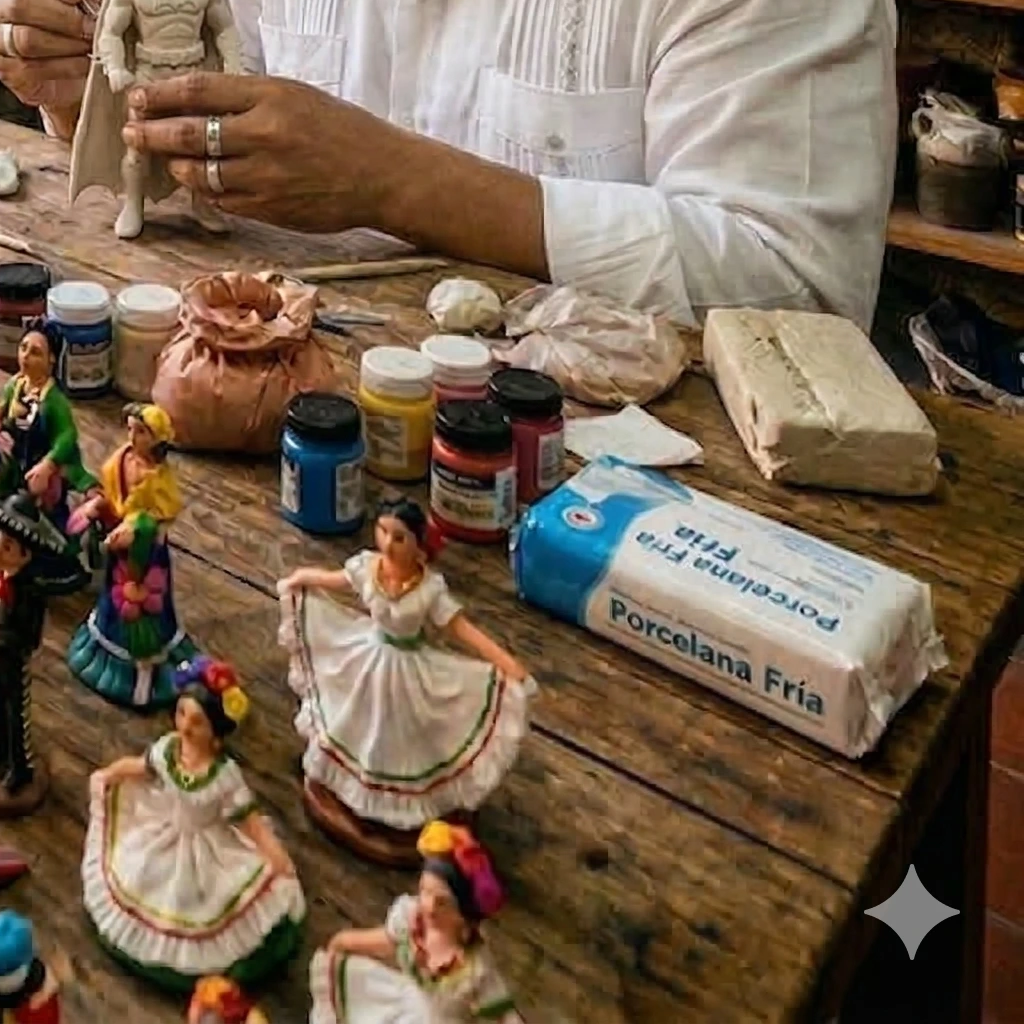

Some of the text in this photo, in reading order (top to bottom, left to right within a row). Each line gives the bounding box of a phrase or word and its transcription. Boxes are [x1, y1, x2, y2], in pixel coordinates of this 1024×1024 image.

[693, 557, 840, 632] Porcelana
[610, 597, 824, 715] Porcelana Fría
